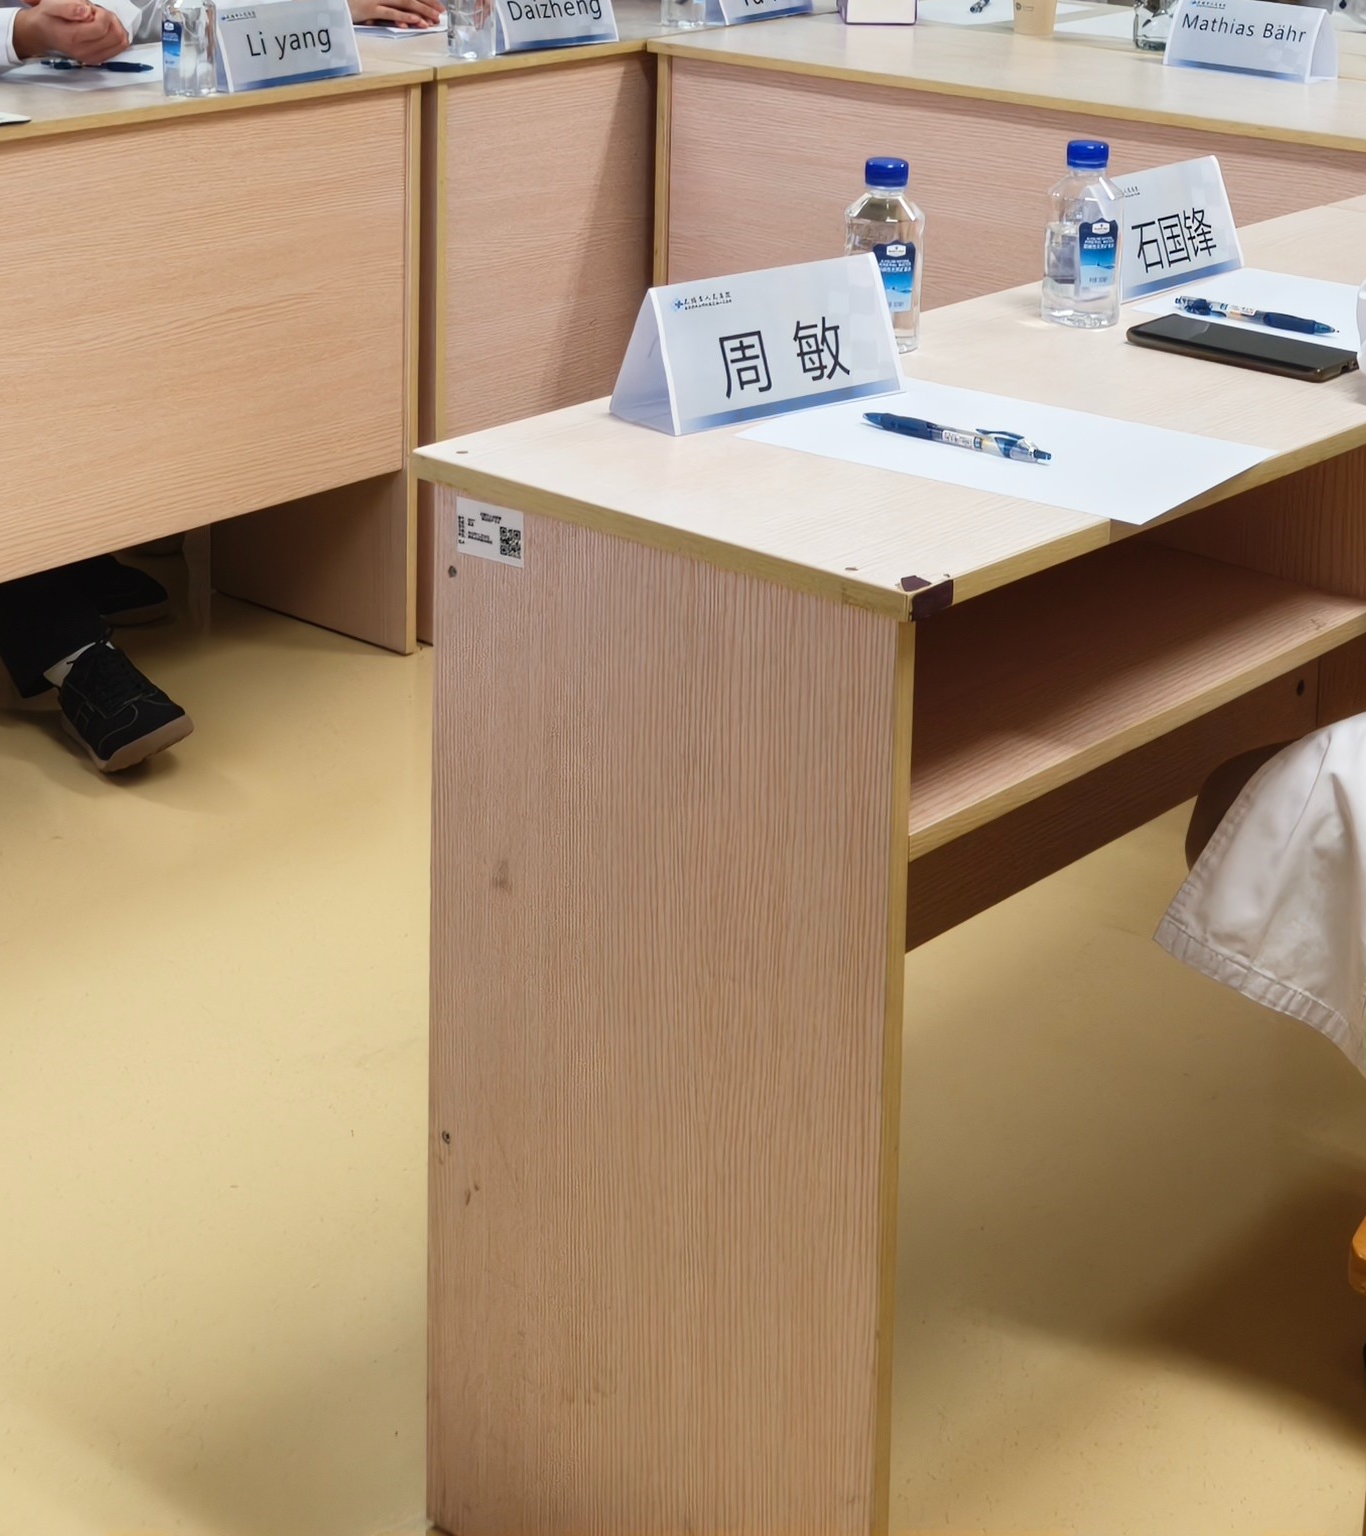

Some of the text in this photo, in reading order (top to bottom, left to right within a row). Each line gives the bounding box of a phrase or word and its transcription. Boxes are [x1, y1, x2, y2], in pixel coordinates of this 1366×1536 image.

[246, 28, 332, 61] Li yang
[1182, 13, 1306, 43] Mathias Bähr
[1131, 207, 1217, 274] 石国锋
[718, 315, 851, 399] 周敏
